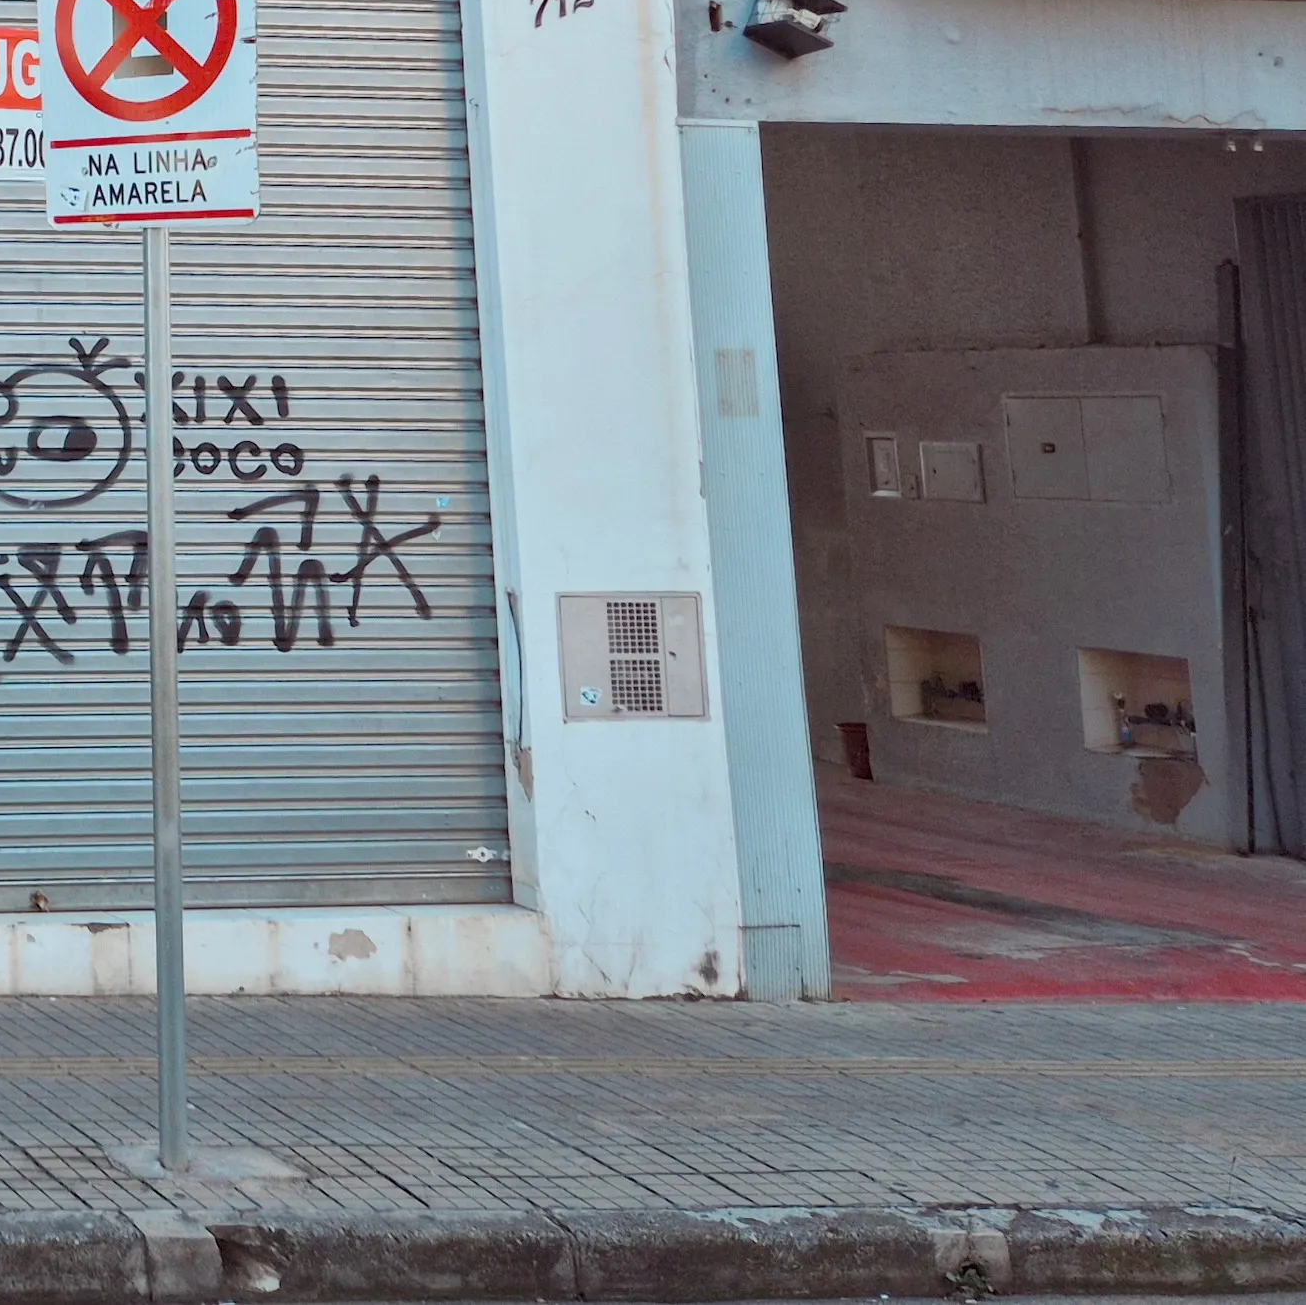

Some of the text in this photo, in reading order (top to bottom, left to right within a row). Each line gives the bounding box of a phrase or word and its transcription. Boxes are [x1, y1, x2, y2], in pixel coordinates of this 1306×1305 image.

[88, 148, 207, 176] NA LINHA
[92, 179, 207, 207] AMARELA
